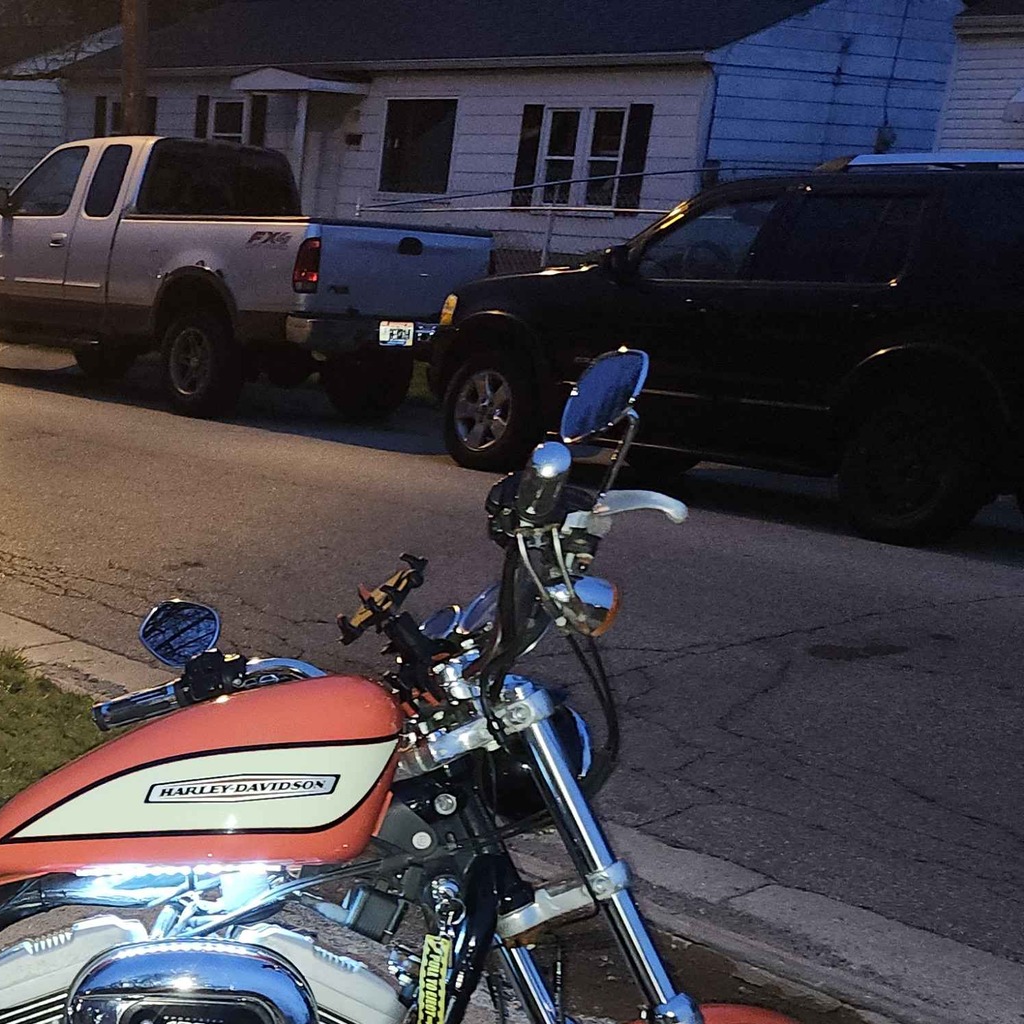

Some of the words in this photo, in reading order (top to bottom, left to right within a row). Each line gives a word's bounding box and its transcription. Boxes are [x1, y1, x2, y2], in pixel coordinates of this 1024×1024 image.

[159, 780, 327, 798] HARLEY-DAVIDSON
[426, 954, 442, 977] PULL
[426, 978, 439, 991] TO
[424, 991, 438, 1018] EJECT
